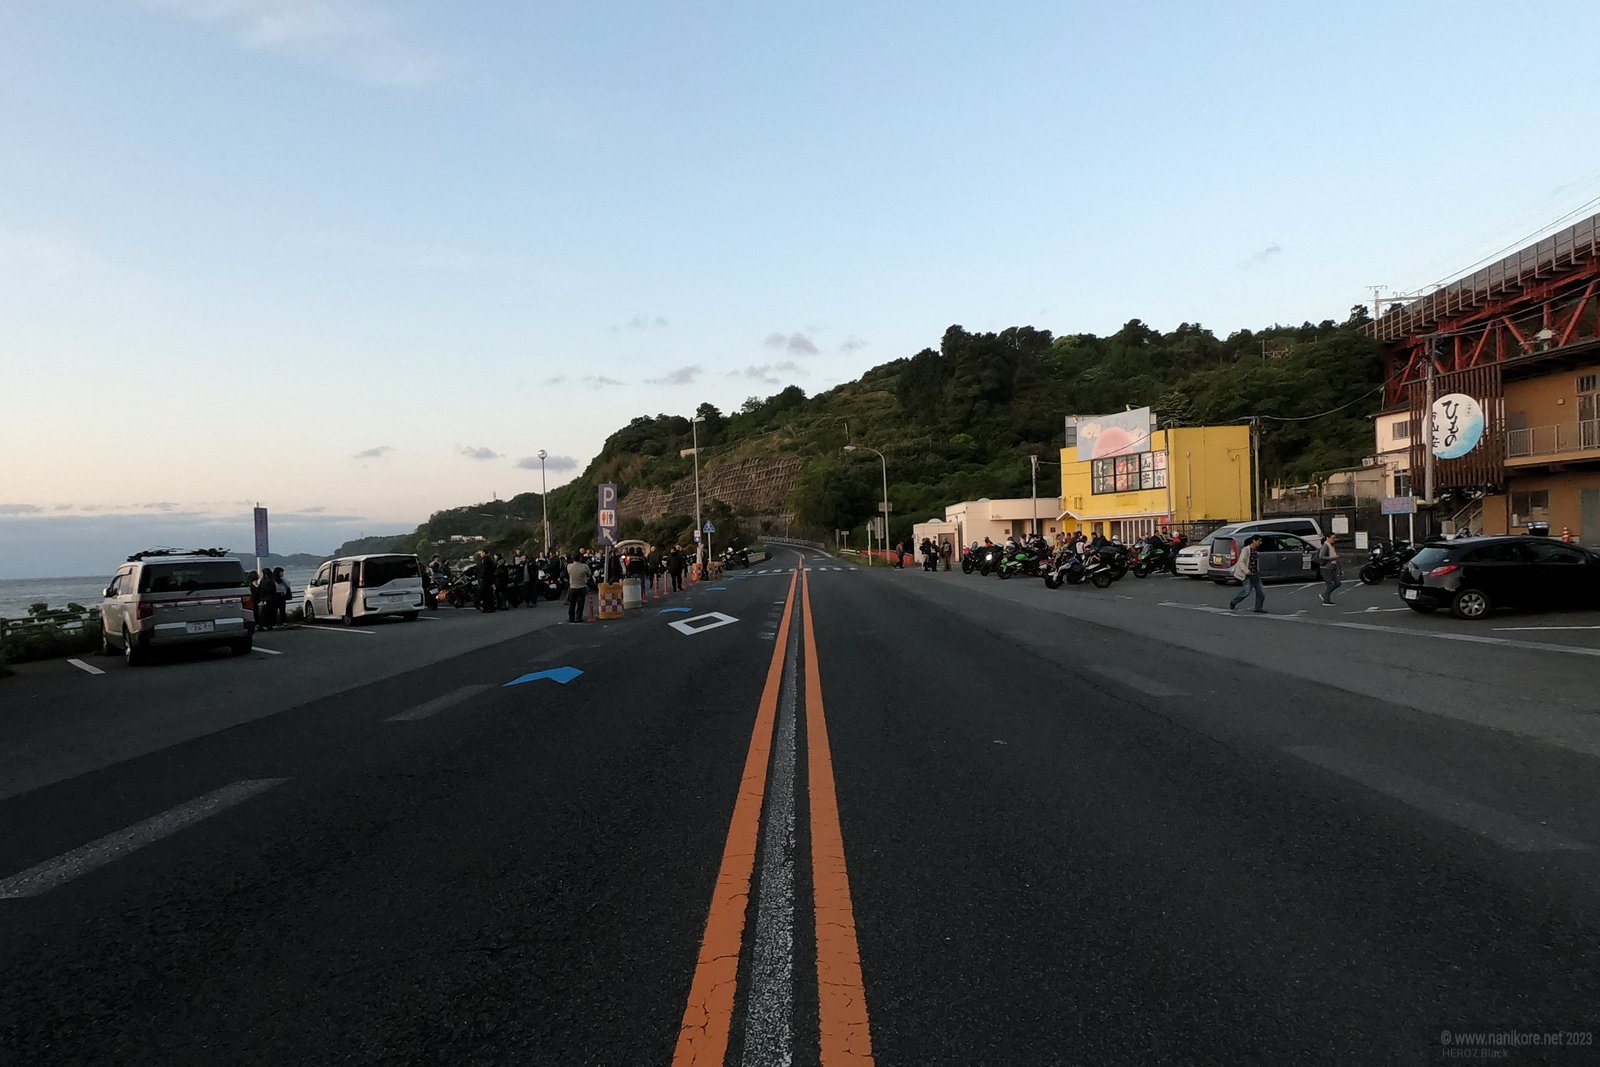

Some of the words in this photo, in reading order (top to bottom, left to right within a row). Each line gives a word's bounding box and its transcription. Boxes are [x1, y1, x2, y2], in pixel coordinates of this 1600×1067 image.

[1441, 400, 1460, 447] ひもの
[603, 487, 615, 508] P
